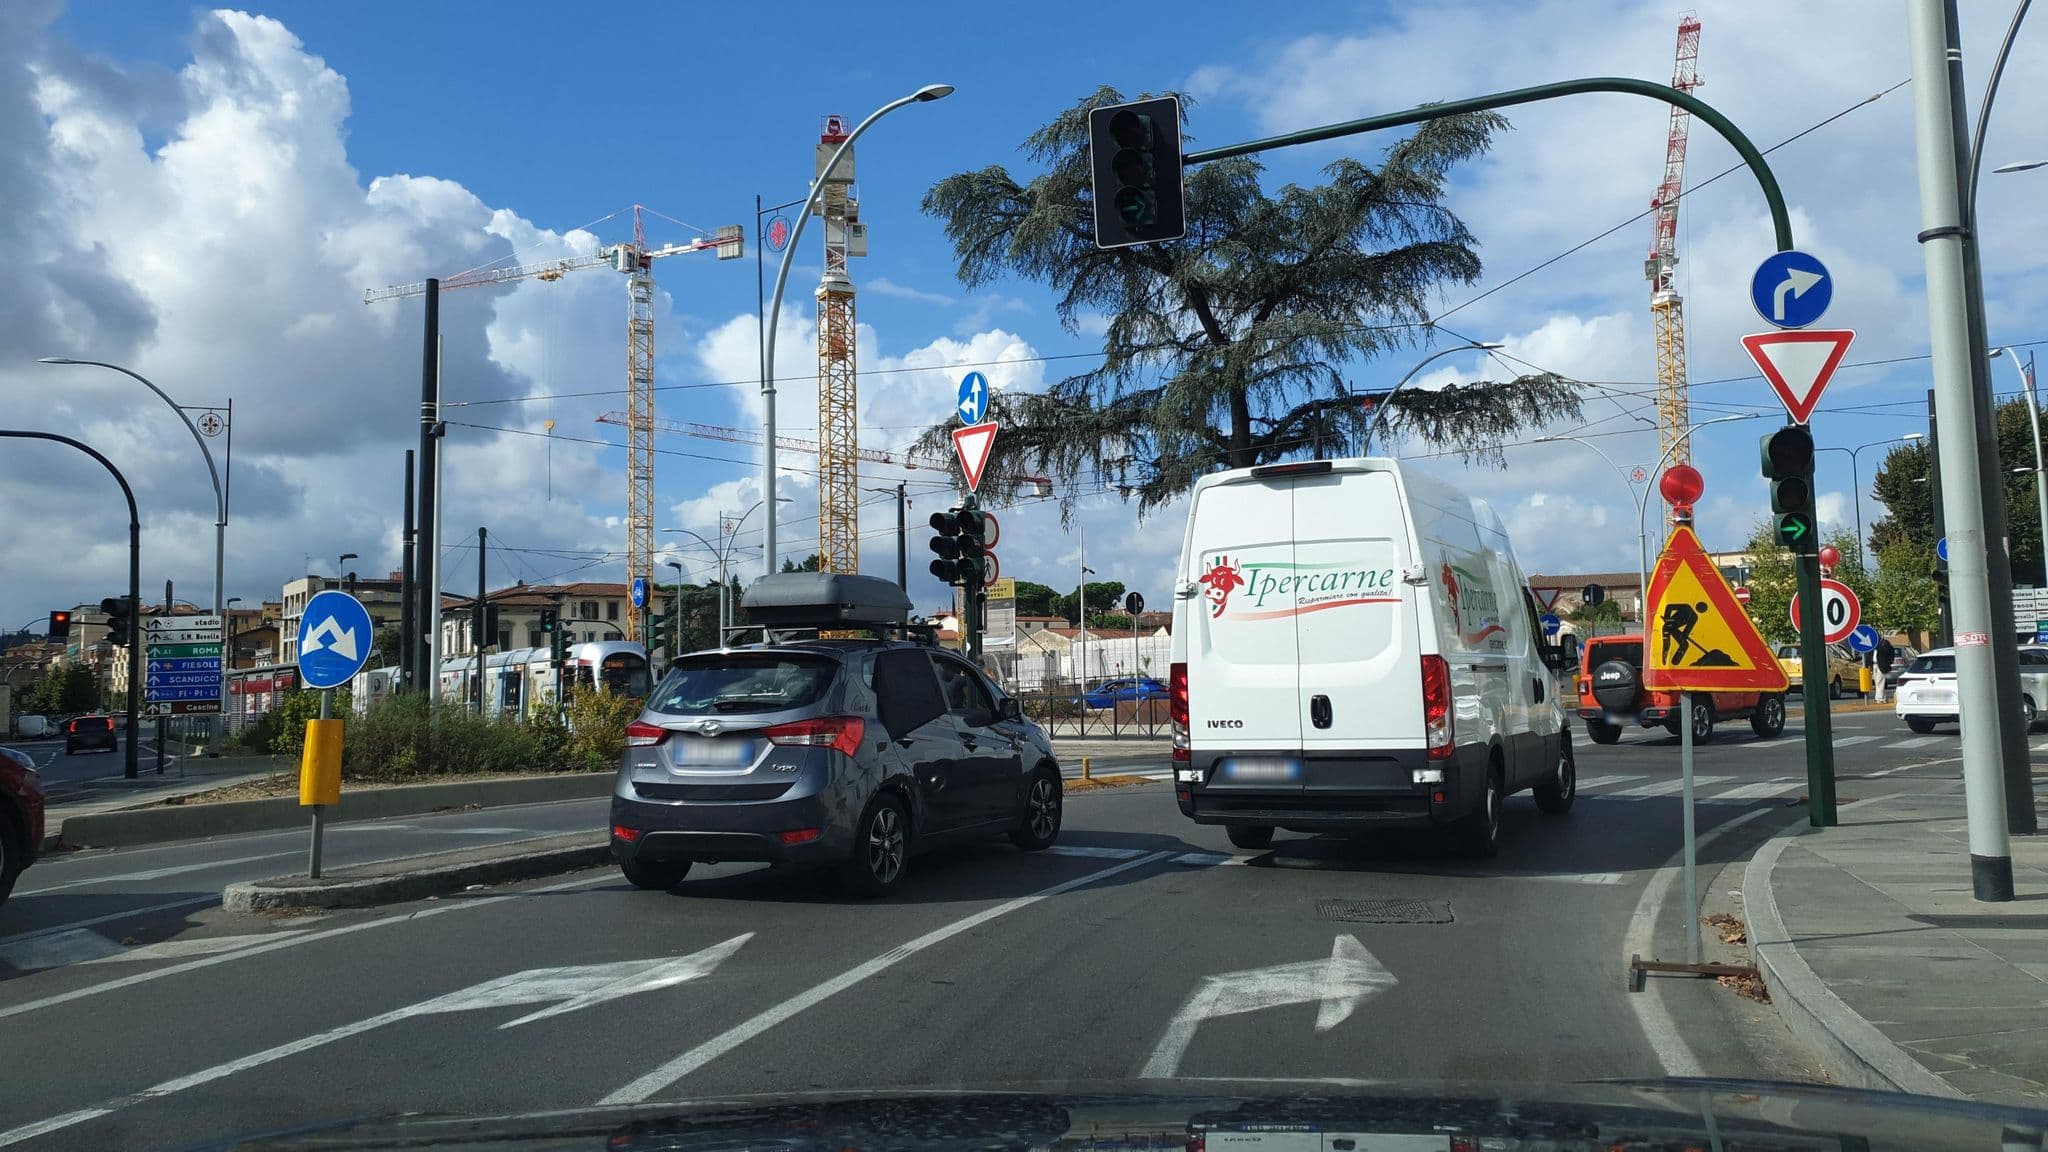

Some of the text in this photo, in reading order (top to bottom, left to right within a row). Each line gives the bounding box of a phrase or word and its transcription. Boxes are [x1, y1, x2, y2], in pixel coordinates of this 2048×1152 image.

[1243, 568, 1393, 607] Ipercarne
[1298, 593, 1343, 605] Risparmiare
[192, 647, 219, 655] ROMA
[182, 661, 219, 669] FIESOLE
[169, 675, 219, 683] SCANDICCI
[1601, 671, 1620, 680] Jeep
[186, 703, 219, 711] Cascine
[1207, 720, 1243, 728] IVECO
